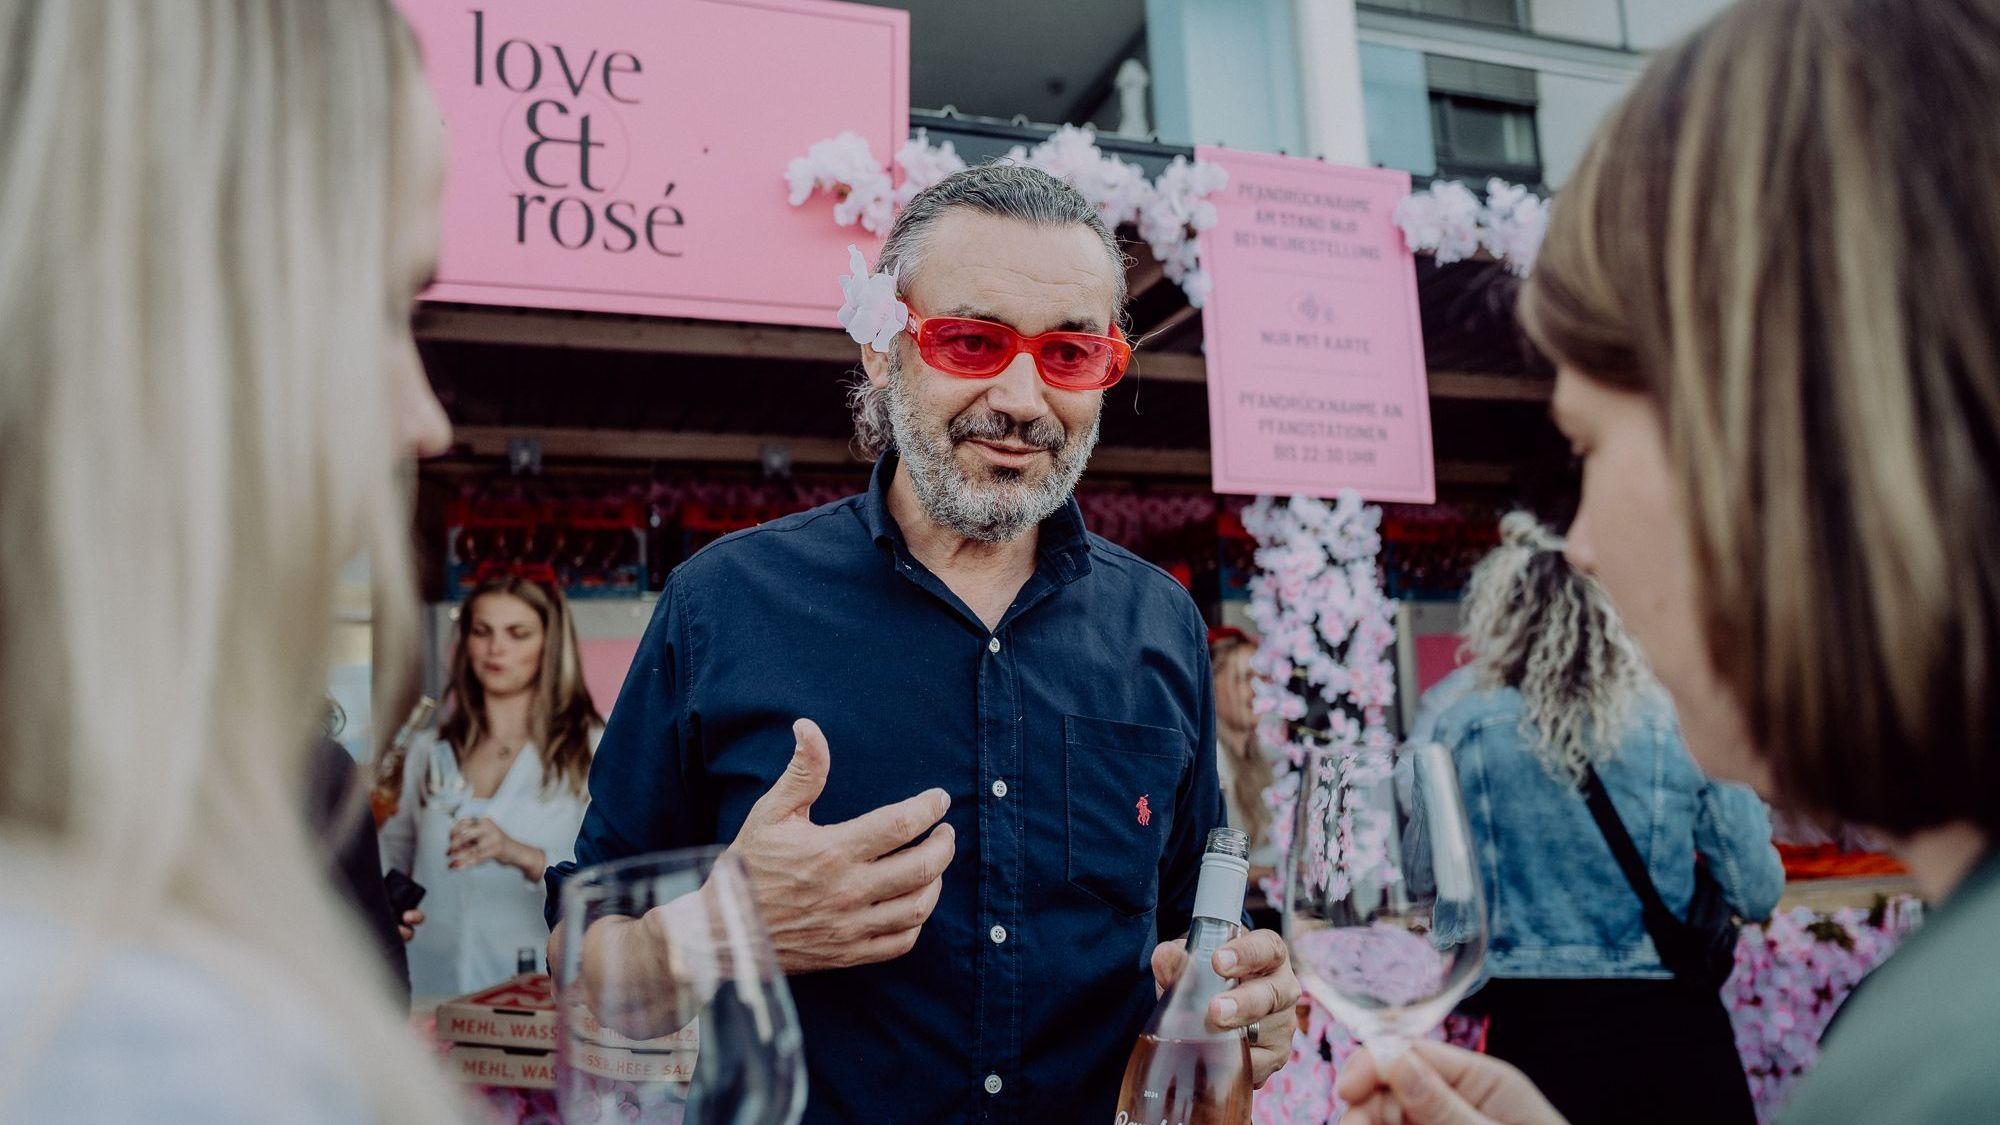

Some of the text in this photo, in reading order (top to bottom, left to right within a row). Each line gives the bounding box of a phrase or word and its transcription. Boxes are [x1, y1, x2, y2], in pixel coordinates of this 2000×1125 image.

[468, 10, 642, 104] love
[510, 182, 684, 257] rosé
[1255, 209, 1359, 234] AM STAND NUR
[1233, 230, 1382, 261] BEI NEUBESTELLUNG
[1260, 330, 1372, 354] NUR MIT KARTE
[1382, 402, 1403, 419] AN
[1258, 418, 1389, 443] PFANDSTATIONEN
[1273, 444, 1298, 462] BIS
[1347, 447, 1377, 466] UHR
